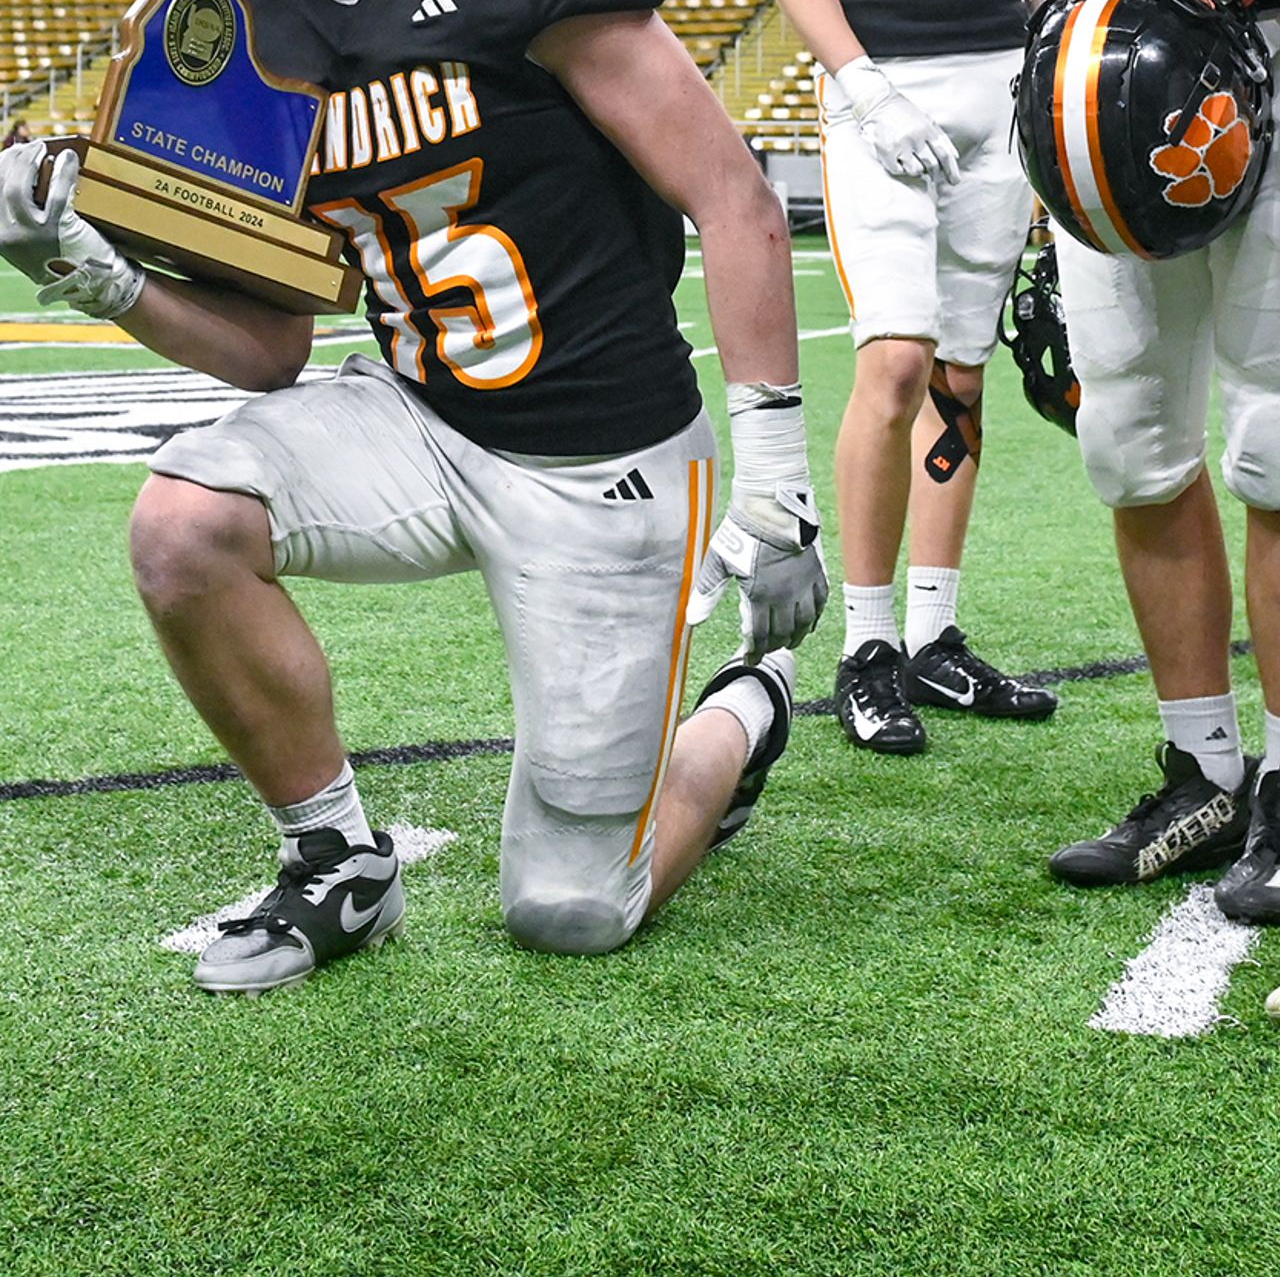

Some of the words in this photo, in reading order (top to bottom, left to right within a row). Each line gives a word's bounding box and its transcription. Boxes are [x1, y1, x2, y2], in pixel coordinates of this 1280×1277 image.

[131, 121, 188, 157] STATE
[191, 144, 285, 194] CHAMPION
[309, 61, 482, 176] NDRICK
[154, 178, 169, 193] 2A
[173, 186, 235, 218] FOOTBALL
[239, 210, 264, 228] 2024
[308, 157, 544, 391] 15
